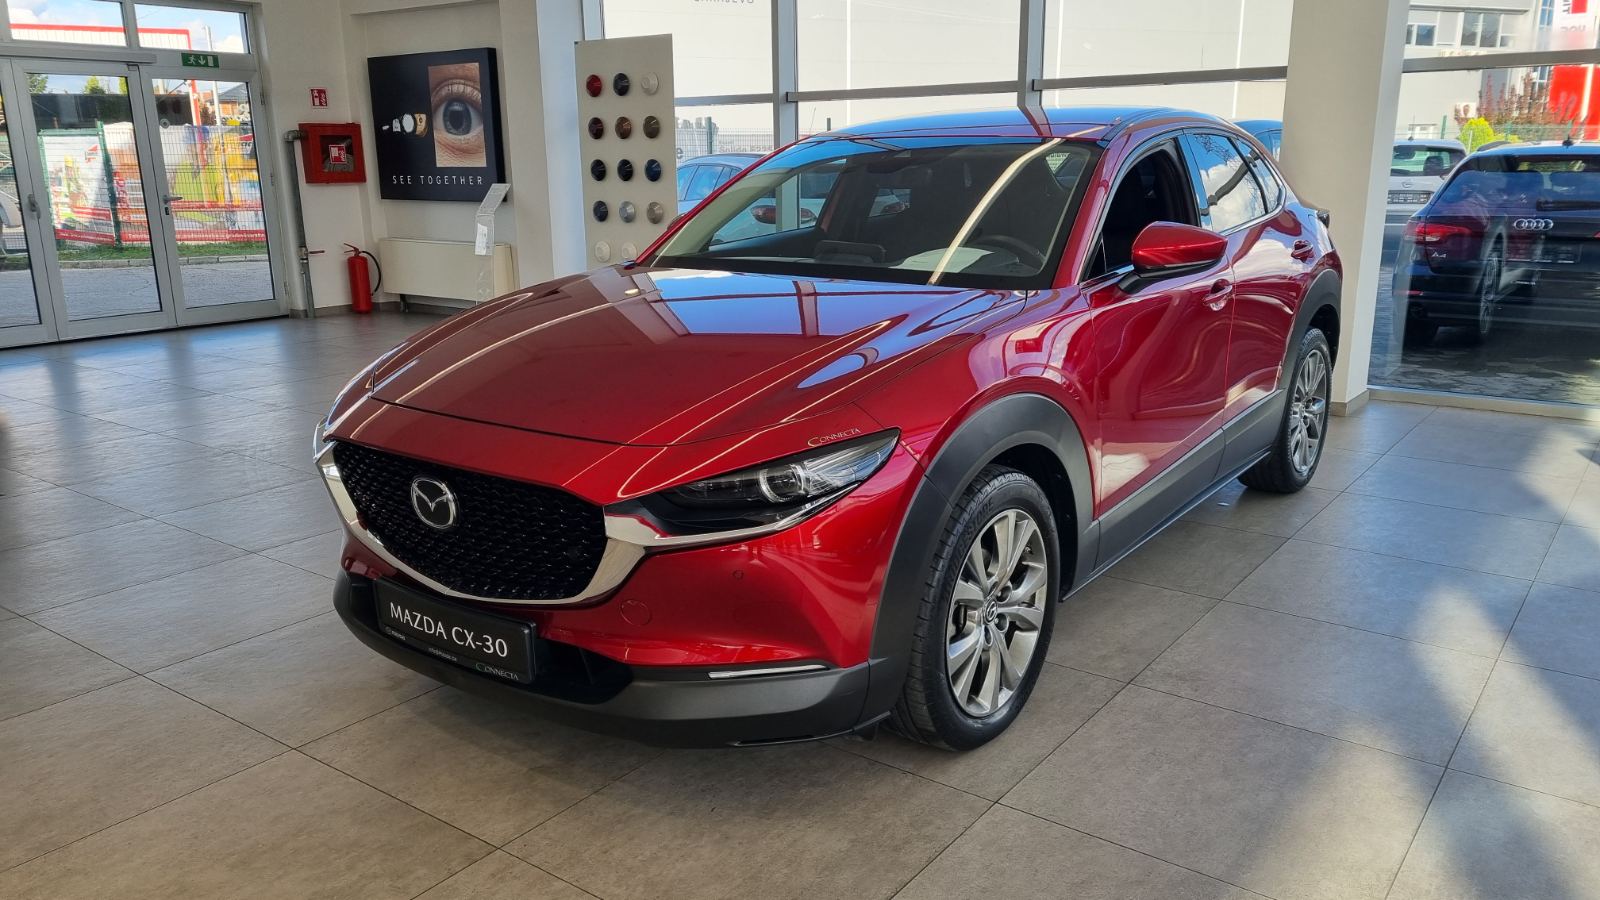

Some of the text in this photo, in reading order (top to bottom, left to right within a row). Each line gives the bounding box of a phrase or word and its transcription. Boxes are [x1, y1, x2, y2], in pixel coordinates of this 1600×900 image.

[392, 175, 483, 185] SEE TOGETHER
[807, 427, 861, 447] CONNECTA
[390, 602, 447, 640] MAZDA
[451, 626, 508, 658] CX-30
[475, 662, 519, 681] CONNECTA
